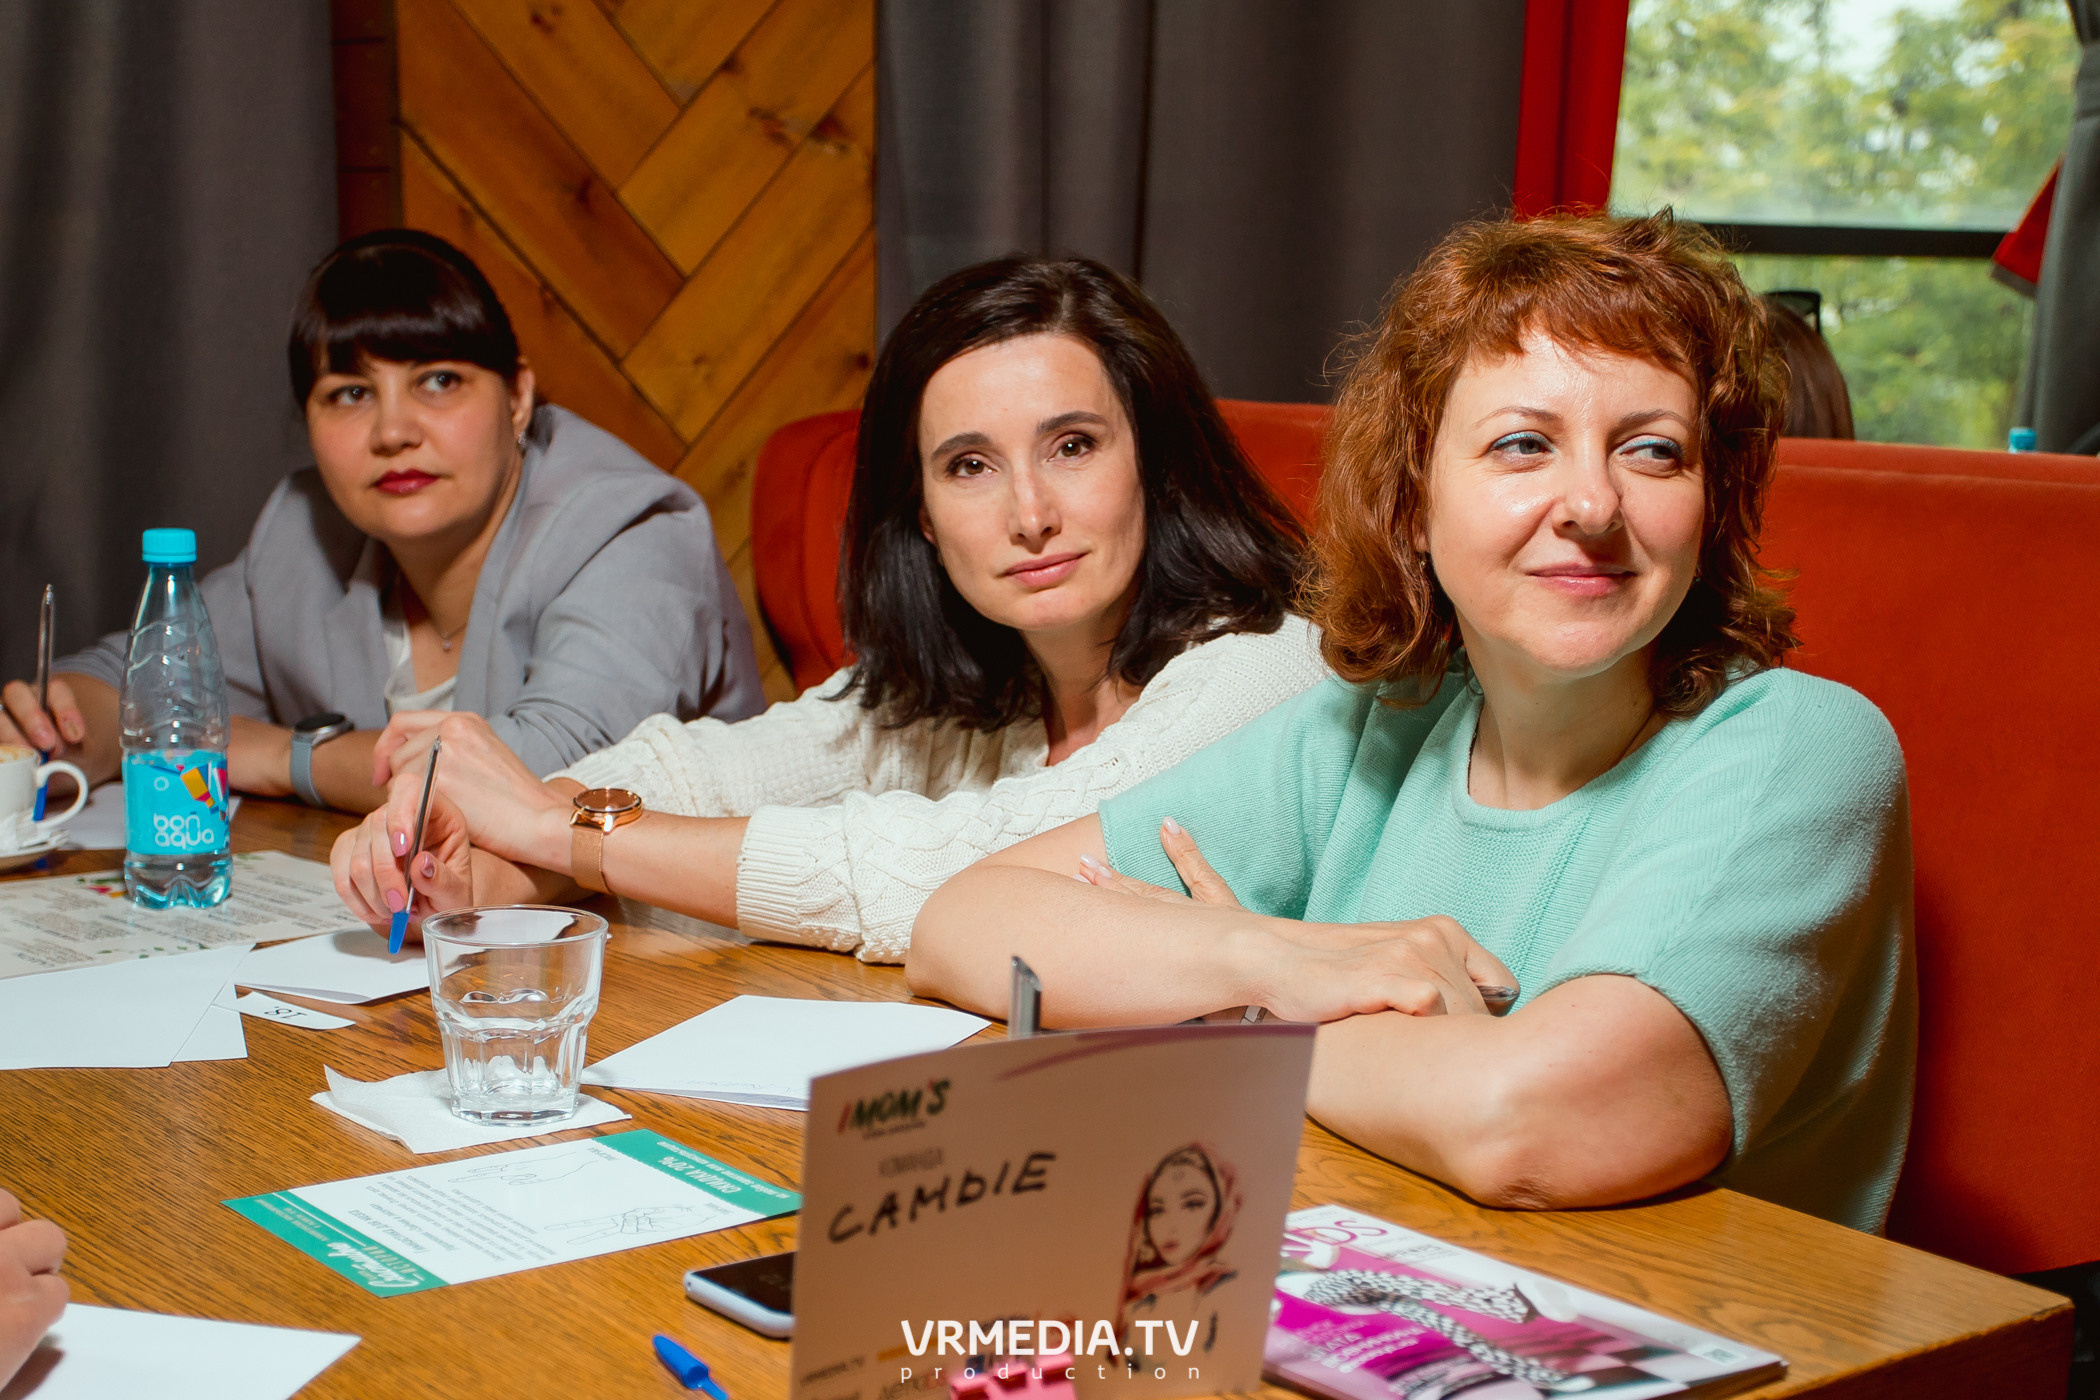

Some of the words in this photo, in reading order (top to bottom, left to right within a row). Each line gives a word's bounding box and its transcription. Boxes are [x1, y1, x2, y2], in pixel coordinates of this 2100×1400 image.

[154, 828, 214, 850] aqua
[659, 1156, 694, 1170] 20%
[682, 1168, 741, 1194] СКИДКА
